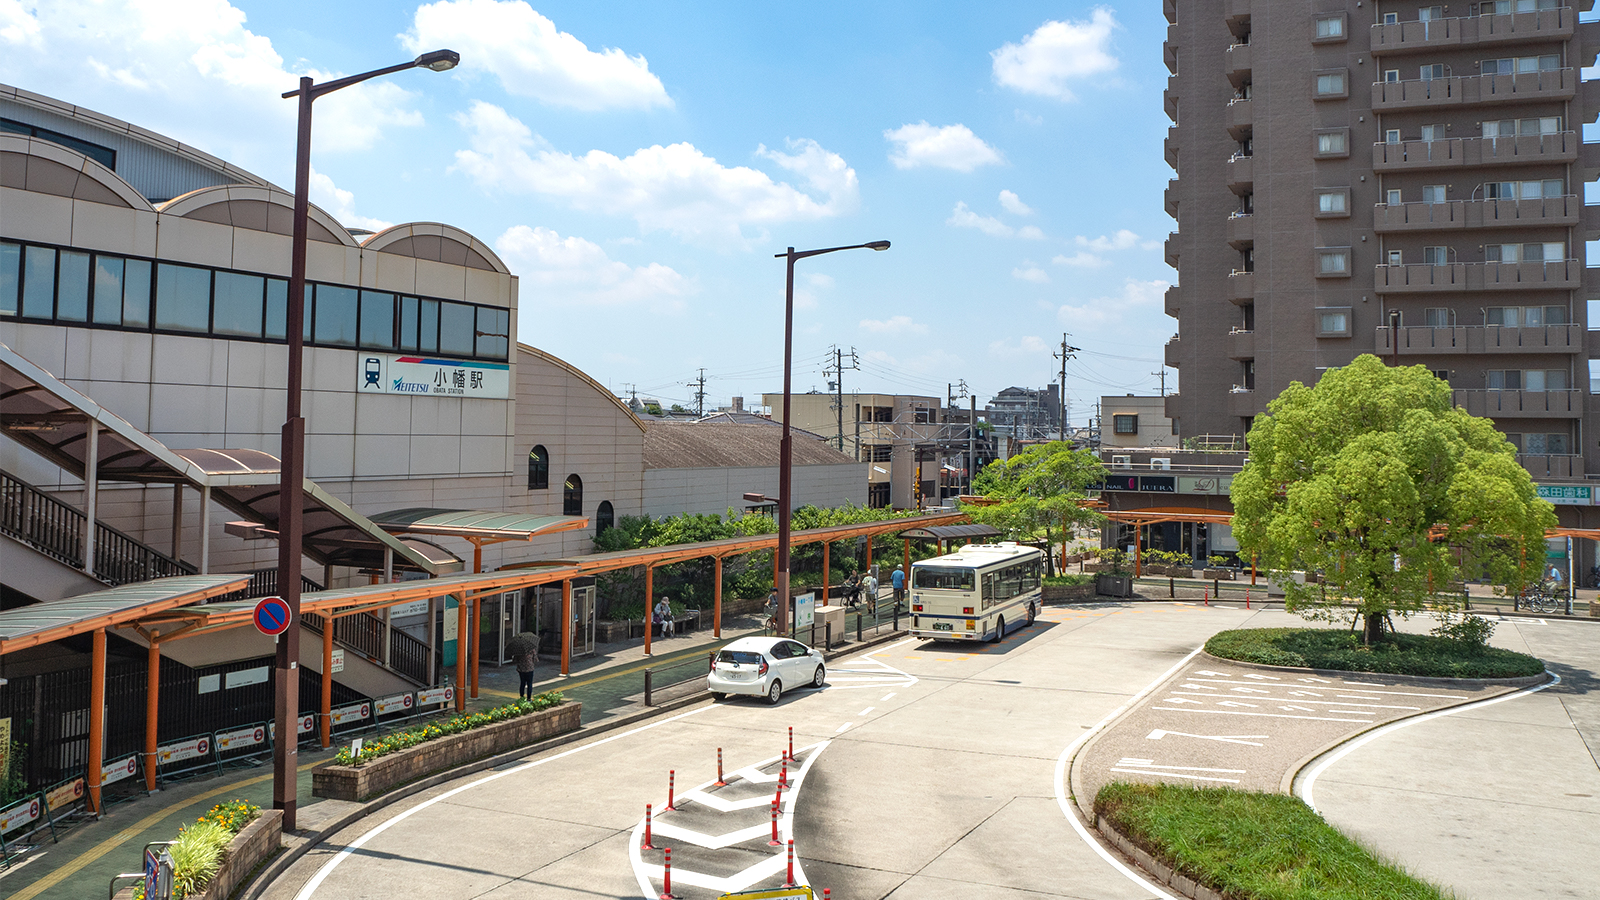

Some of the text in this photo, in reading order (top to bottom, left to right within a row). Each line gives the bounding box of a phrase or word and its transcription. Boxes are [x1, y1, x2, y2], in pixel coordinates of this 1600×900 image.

[391, 376, 430, 393] MEITETSU
[433, 368, 483, 389] 小幡駅
[1537, 487, 1588, 497] 森田歯科
